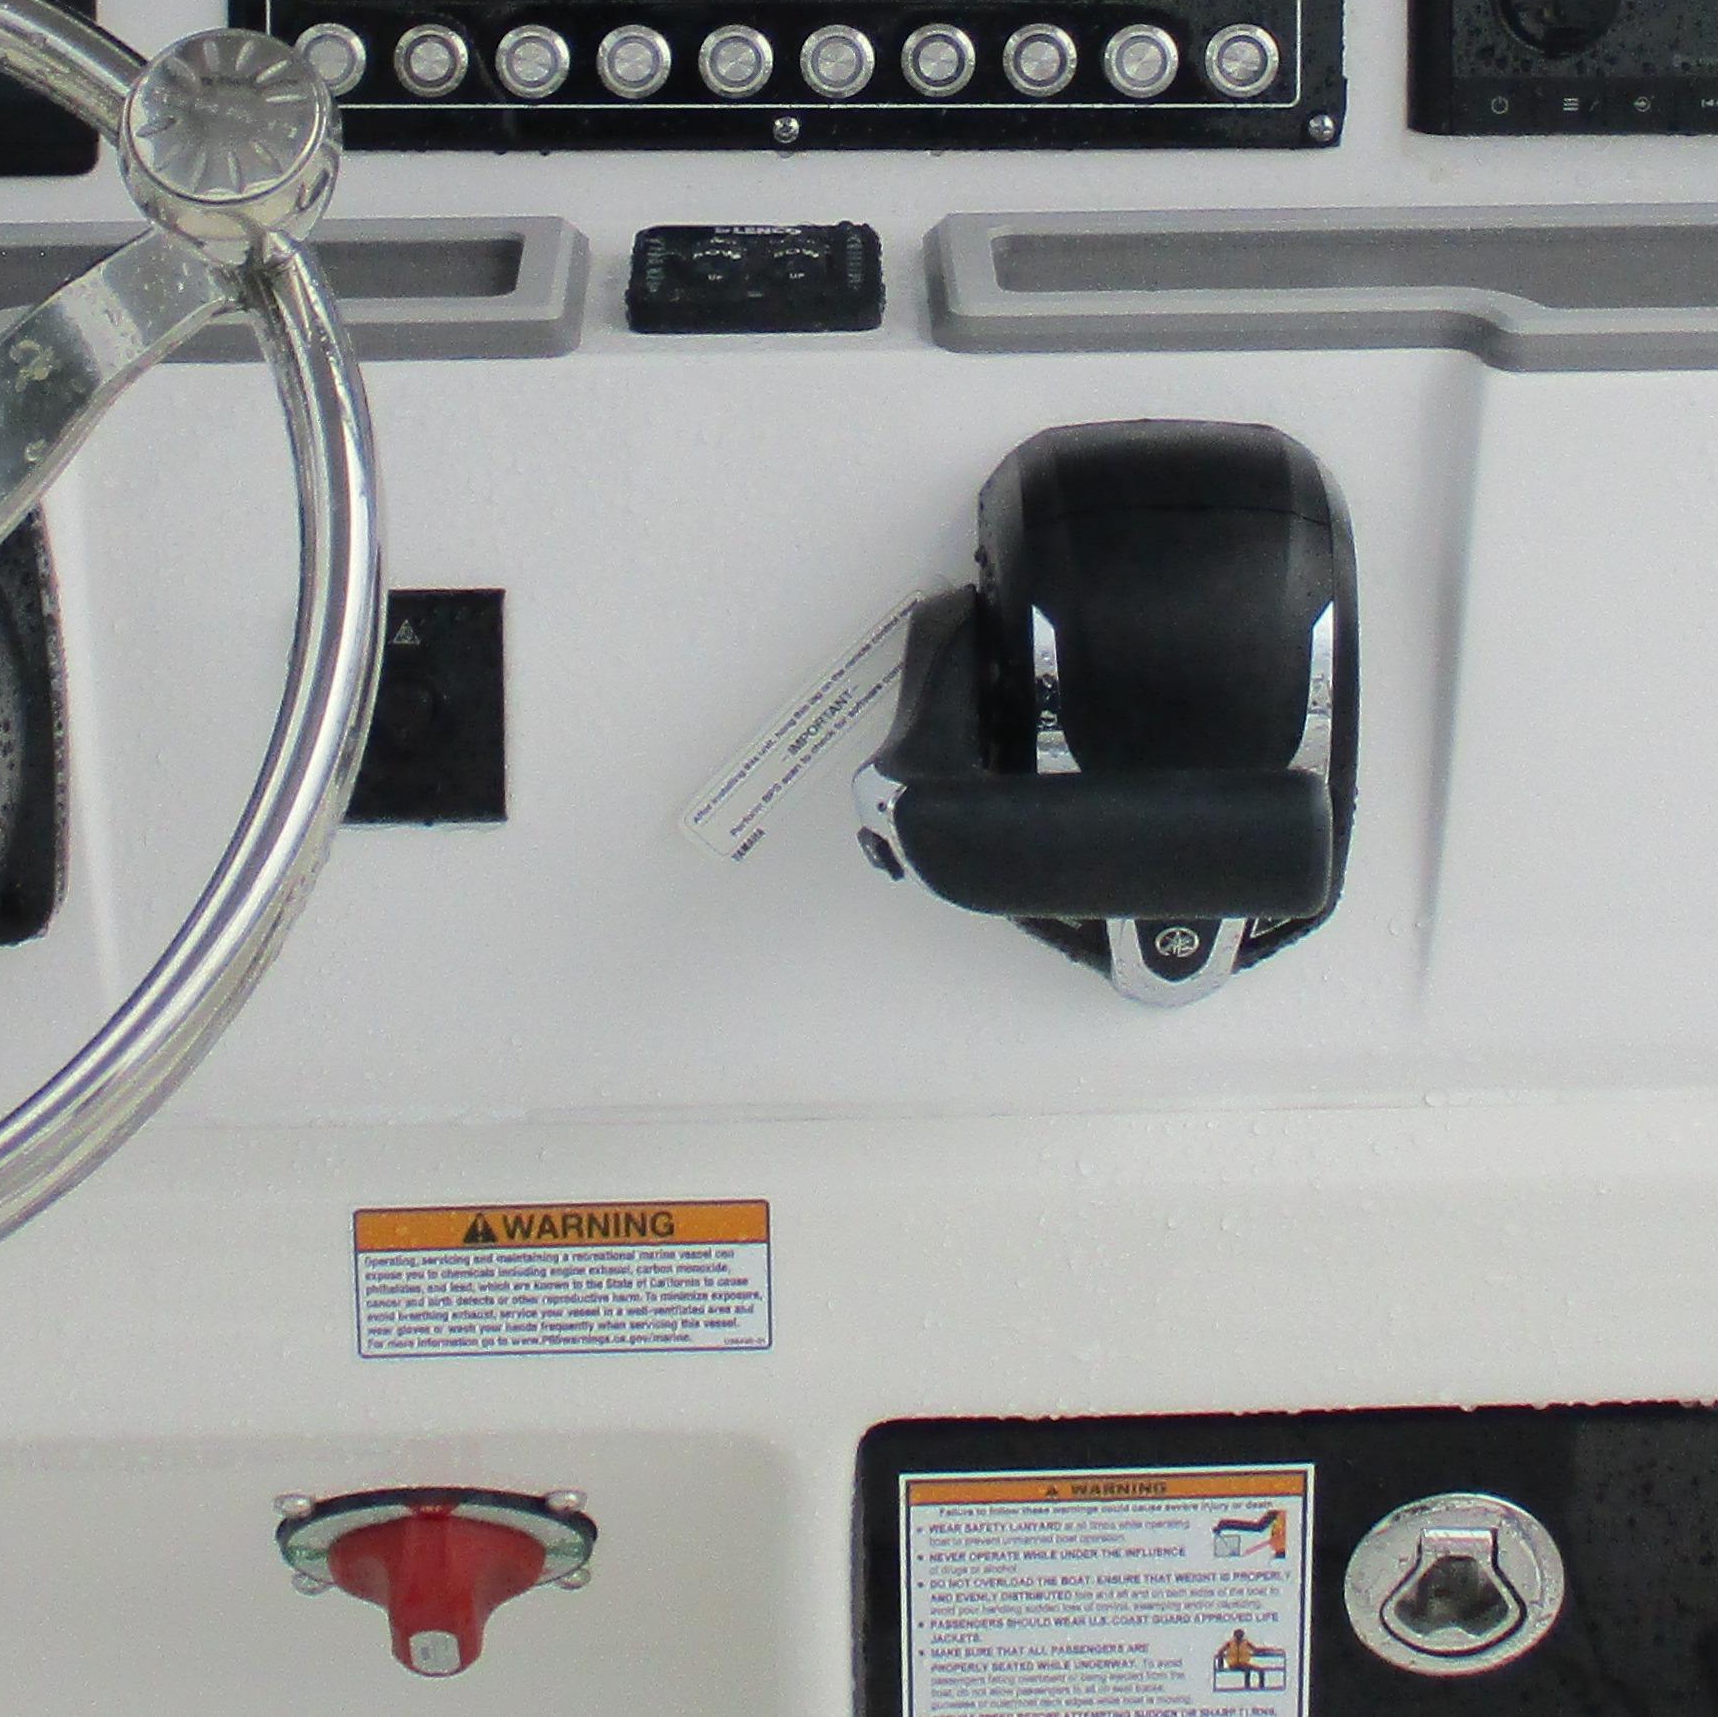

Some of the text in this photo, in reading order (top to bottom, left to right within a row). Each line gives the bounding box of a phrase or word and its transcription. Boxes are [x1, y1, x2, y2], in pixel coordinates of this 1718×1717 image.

[787, 689, 854, 756] IMPORTANT
[731, 827, 767, 862] YAMAHA
[503, 1211, 675, 1241] WARNING
[1070, 1481, 1168, 1496] WARNING
